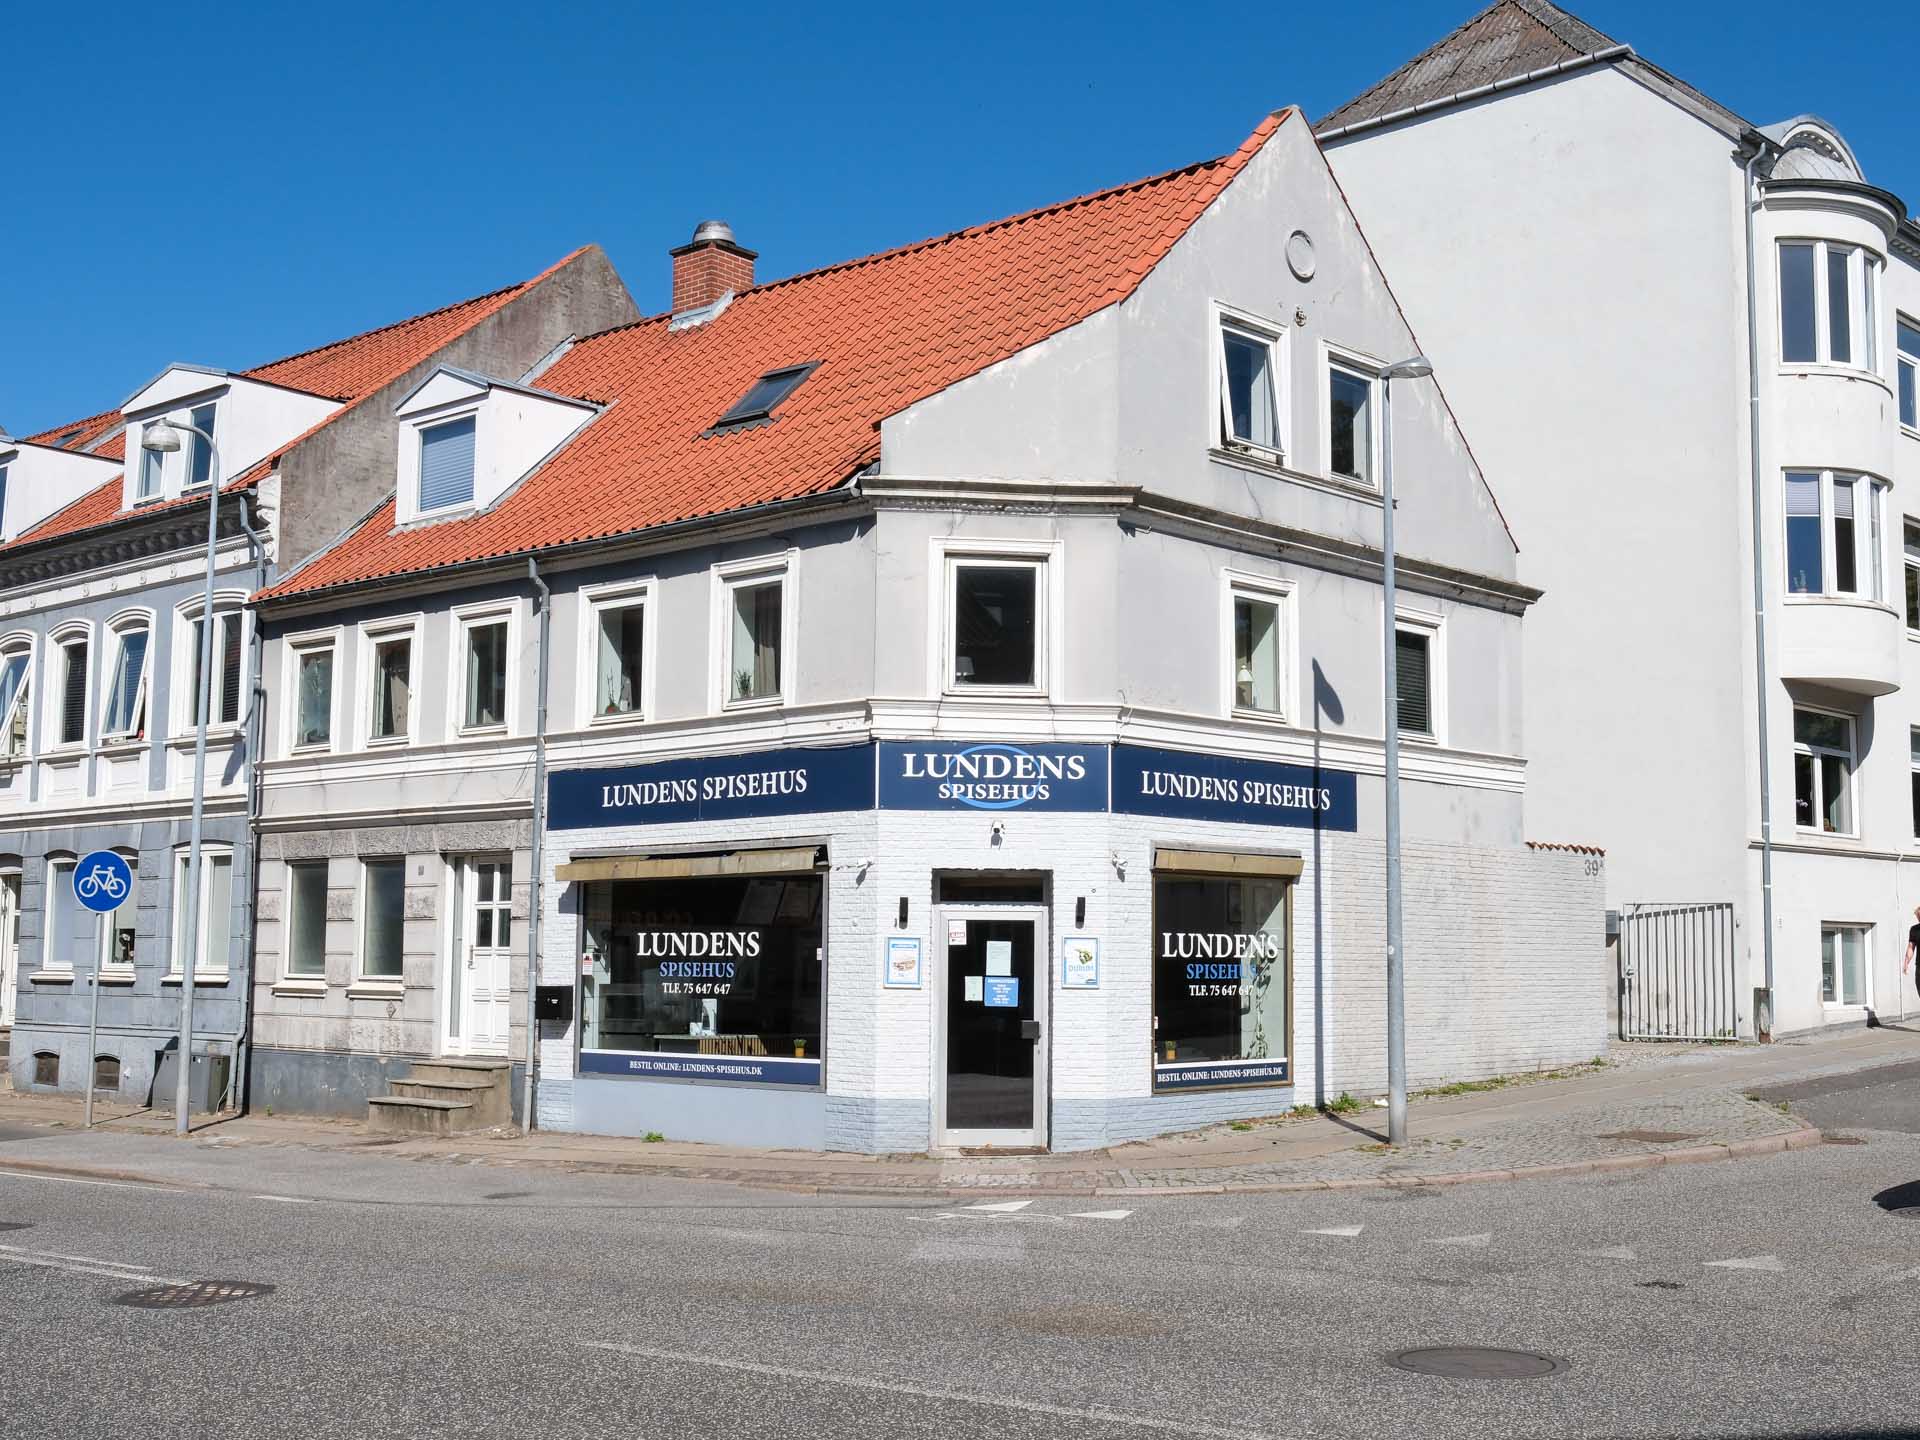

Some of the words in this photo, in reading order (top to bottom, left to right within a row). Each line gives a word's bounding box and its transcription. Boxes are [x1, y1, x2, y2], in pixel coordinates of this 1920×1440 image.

[903, 753, 1086, 780] LUNDENS
[602, 778, 697, 808] LUNDENS
[702, 769, 807, 800] SPISEHUS
[938, 783, 1050, 801] SPISEHUS
[1141, 770, 1239, 803] LUNDENS
[1243, 780, 1331, 811] SPISEHUS
[636, 931, 760, 957] LUNDENS
[1162, 932, 1279, 959] LUNDENS
[659, 962, 735, 978] SPISEHUS
[1186, 963, 1258, 980] SPISEHUS
[662, 982, 682, 994] TLF.
[683, 983, 694, 994] 75
[695, 983, 712, 995] 647
[714, 983, 731, 995] 647
[1189, 984, 1208, 997] TLF.
[1210, 984, 1221, 997] 75
[1222, 984, 1238, 997] 647
[1238, 985, 1255, 997] 647
[629, 1060, 652, 1071] BESTIL
[653, 1062, 682, 1072] ONLINE:
[682, 1062, 763, 1076] LUNDENS-SPISEHUS.DK
[1157, 1071, 1182, 1082] BESTIL
[1182, 1070, 1210, 1081] ONLINE:
[1210, 1067, 1283, 1079] LUNDENS-SPISEHUS.DK
